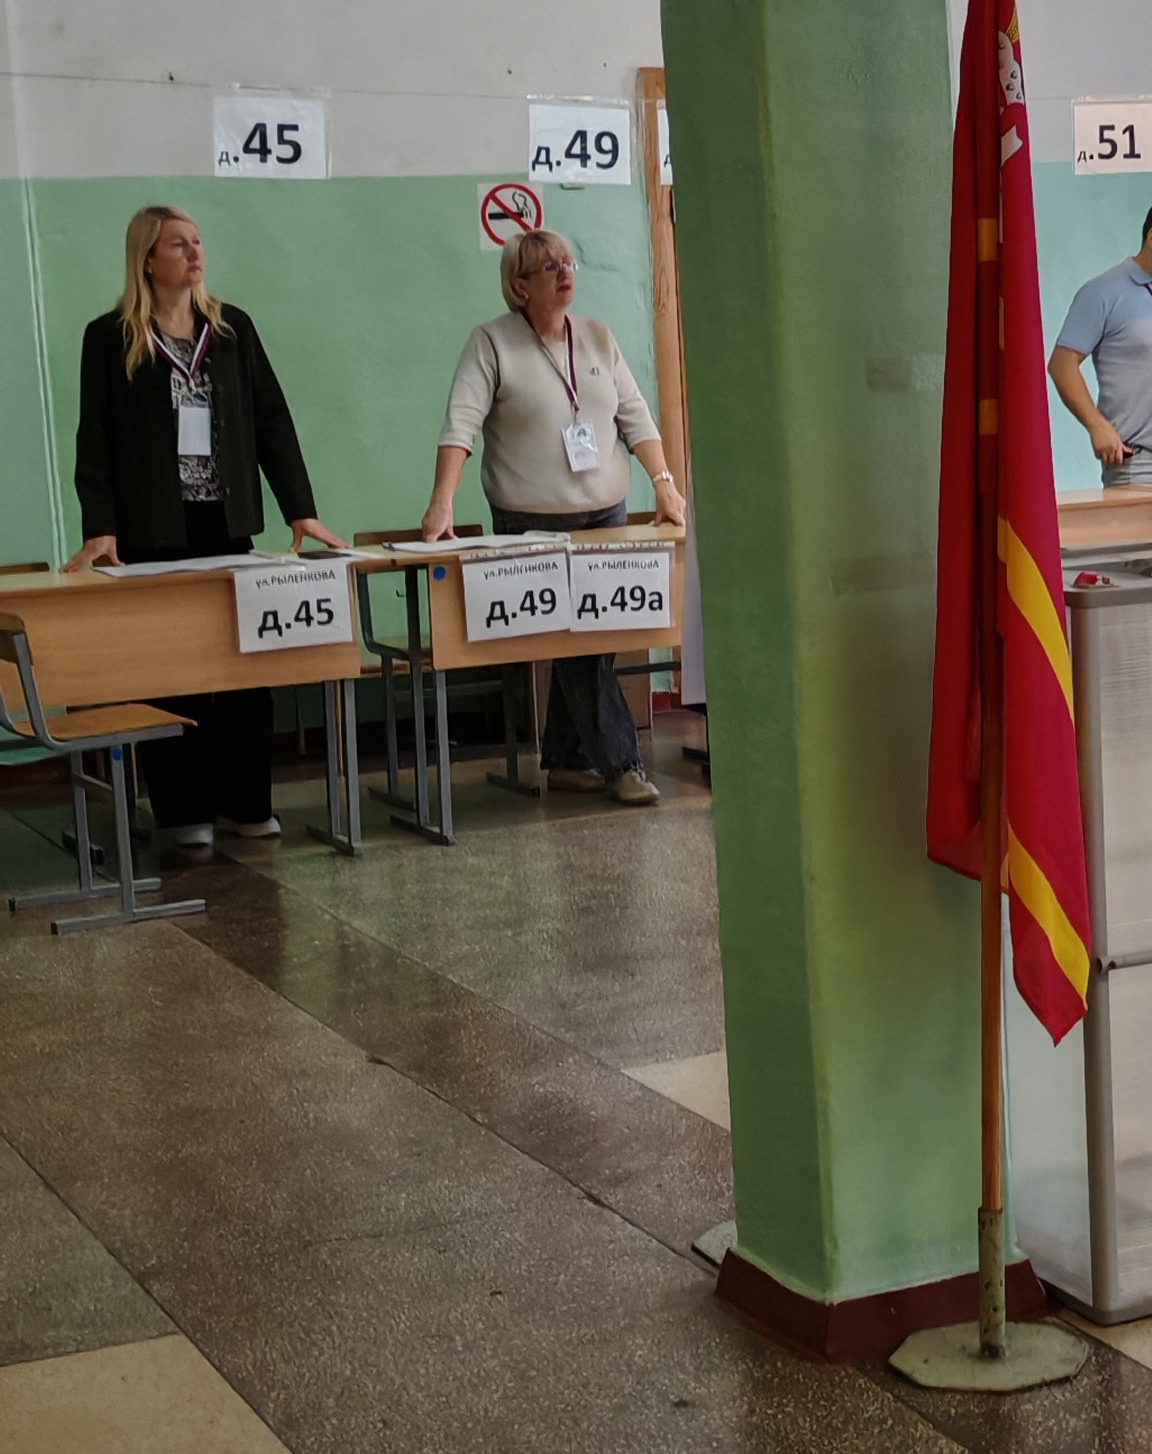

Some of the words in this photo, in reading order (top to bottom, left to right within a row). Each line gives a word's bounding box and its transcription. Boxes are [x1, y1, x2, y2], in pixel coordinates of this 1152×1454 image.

[218, 122, 302, 167] д.45
[531, 129, 619, 173] д.49
[1077, 124, 1141, 163] д.51
[258, 598, 334, 639] д.45
[486, 588, 557, 628] д.49
[577, 585, 663, 620] д.49а
